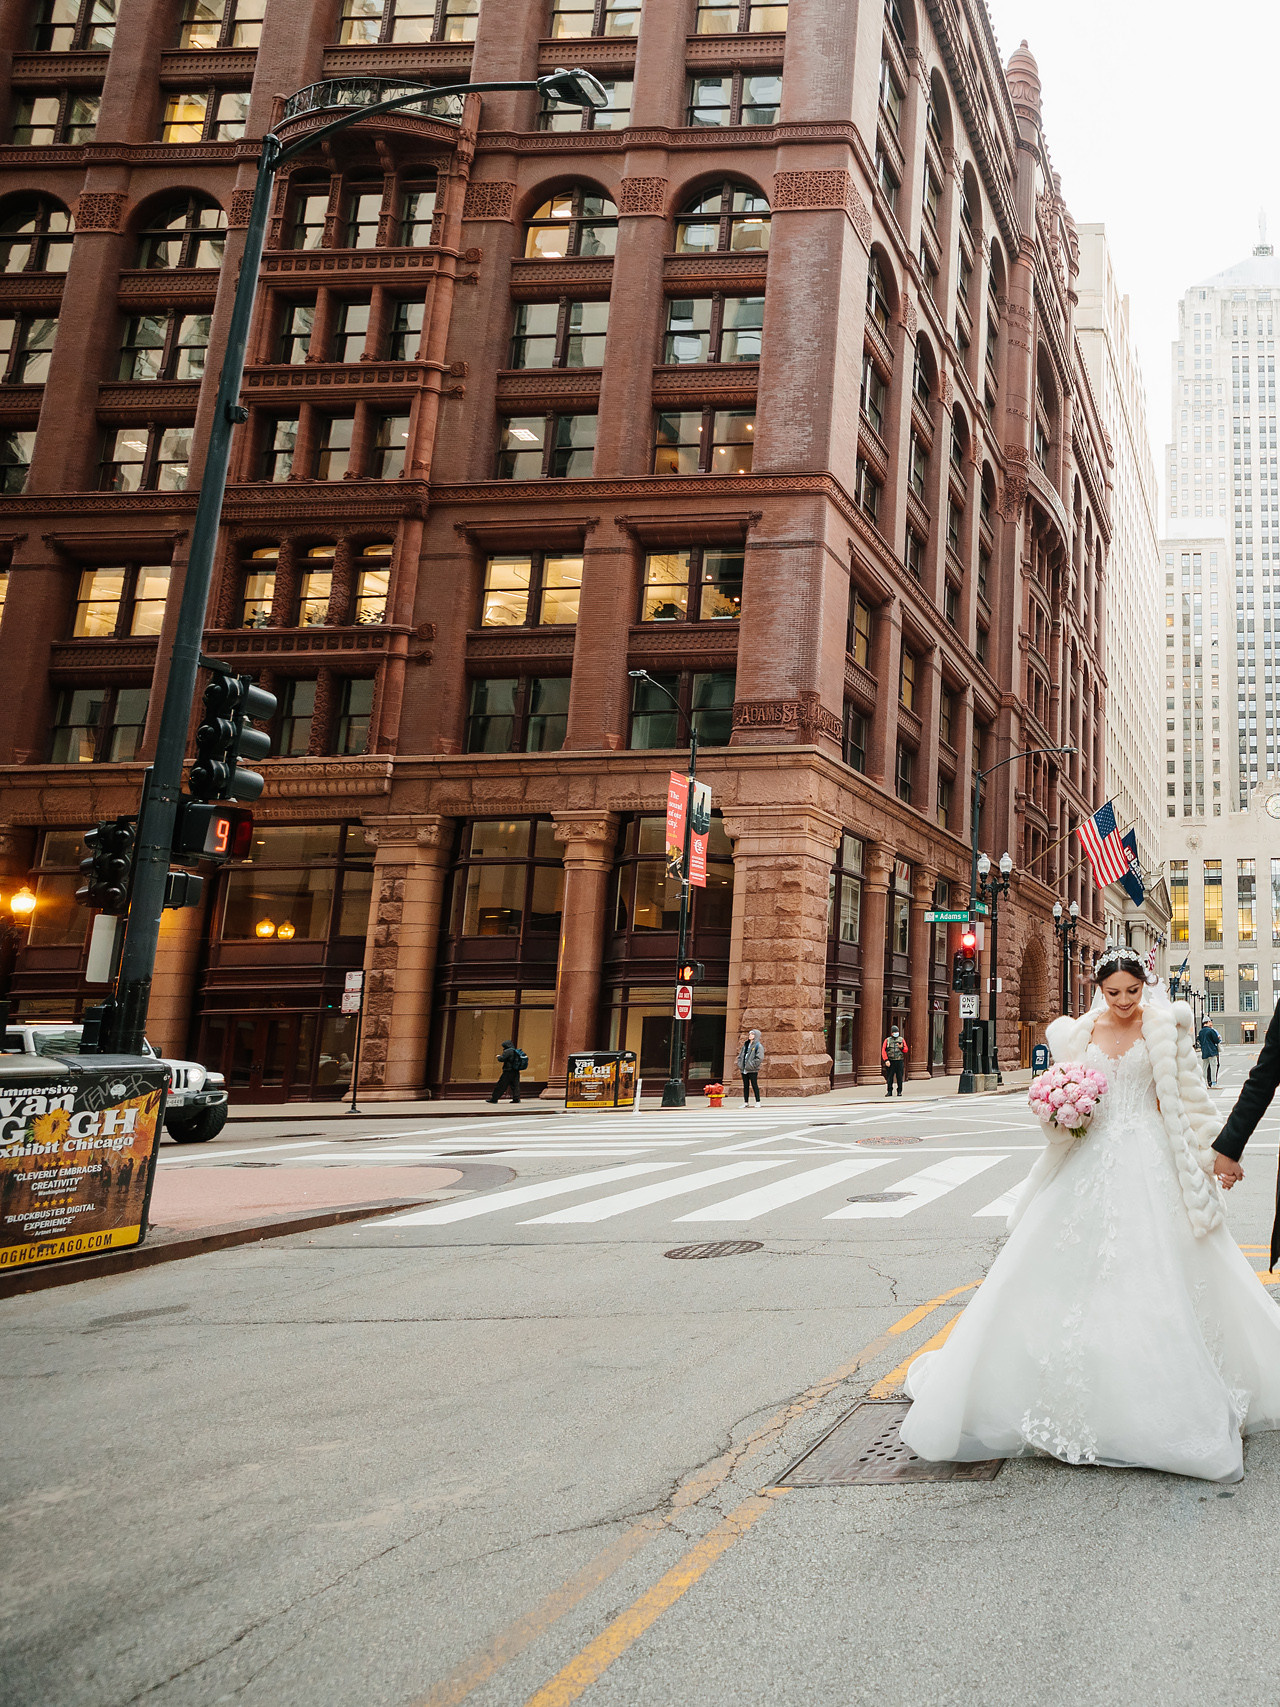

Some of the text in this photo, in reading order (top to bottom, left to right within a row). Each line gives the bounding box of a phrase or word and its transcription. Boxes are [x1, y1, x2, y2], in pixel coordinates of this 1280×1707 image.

[740, 706, 782, 724] ADAMS
[670, 790, 679, 800] The
[215, 819, 230, 852] 9
[0, 1084, 78, 1097] Immersive
[0, 1093, 75, 1117] van
[62, 1135, 134, 1152] Chicago
[13, 1164, 102, 1182] "CLEVERLY EMBRACES
[31, 1177, 83, 1191] CREATIVITY"
[4, 1203, 96, 1224] "BLOCKBUSTER DIGITAL
[23, 1216, 76, 1231] EXPERIENCE"
